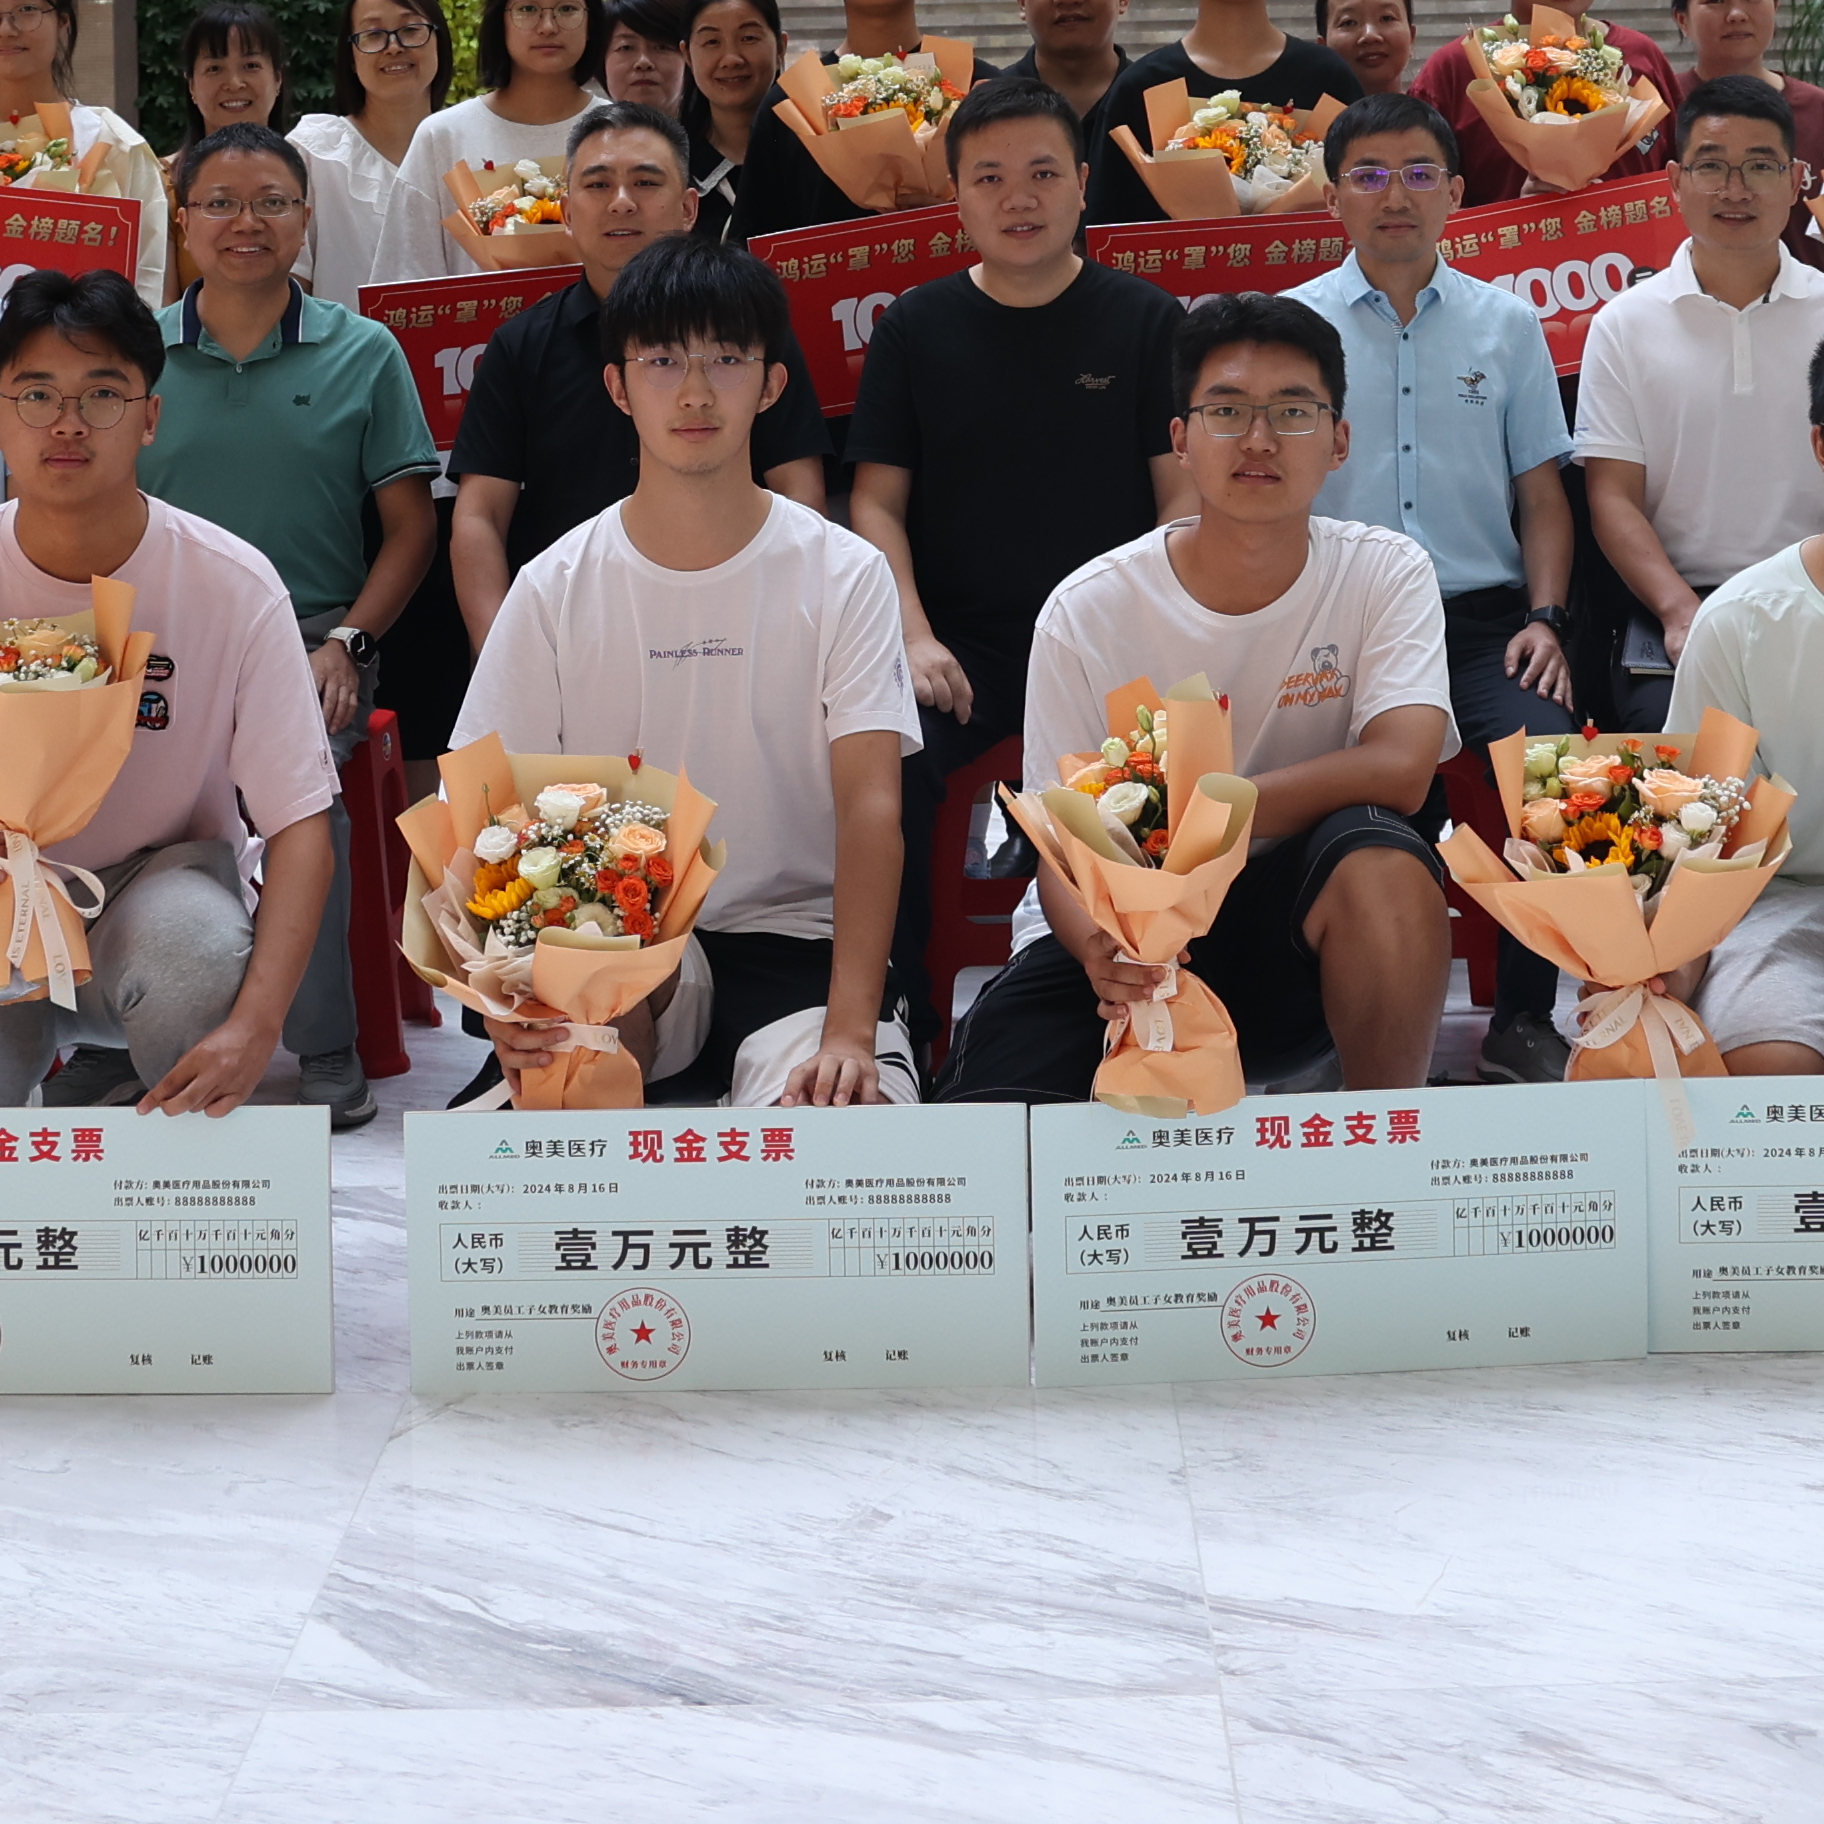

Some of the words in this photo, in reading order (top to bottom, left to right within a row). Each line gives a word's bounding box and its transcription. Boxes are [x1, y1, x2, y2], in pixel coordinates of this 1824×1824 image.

[1574, 195, 1675, 236] 金榜题名
[2, 212, 120, 248] 金榜题名!
[775, 237, 916, 283] 鸿运“罩”您
[927, 228, 980, 260] 金榜
[1111, 242, 1252, 274] 鸿运“罩”您
[1264, 236, 1348, 266] 金榜题
[382, 295, 524, 331] 鸿运“罩”您
[649, 648, 698, 660] PAINLESS
[702, 646, 744, 657] RUNNER
[15, 880, 31, 942] ETERNAL
[1150, 1124, 1235, 1149] 奥美医疗
[1254, 1108, 1421, 1150] 现金支票
[523, 1137, 608, 1159] 奥美医疗
[627, 1126, 795, 1164] 现金支票
[1468, 1152, 1589, 1168] 奥美医疗用品股份有限公司
[151, 1178, 271, 1190] 奥美医疗用品股份有限公司
[843, 1176, 966, 1189] 奥美医疗用品股份有限公司
[1148, 1168, 1245, 1184] 2024年8月16日
[521, 1181, 619, 1195] 2024年8月16日
[1689, 1194, 1743, 1212] 人民币
[1076, 1222, 1130, 1243] 人民币
[1179, 1206, 1395, 1261] 壹万元整
[1691, 1218, 1742, 1237] (大写)
[451, 1231, 504, 1250] 人民币
[552, 1224, 770, 1271] 壹万元整
[453, 1255, 504, 1275] (大写)
[1078, 1247, 1129, 1268] (大写)
